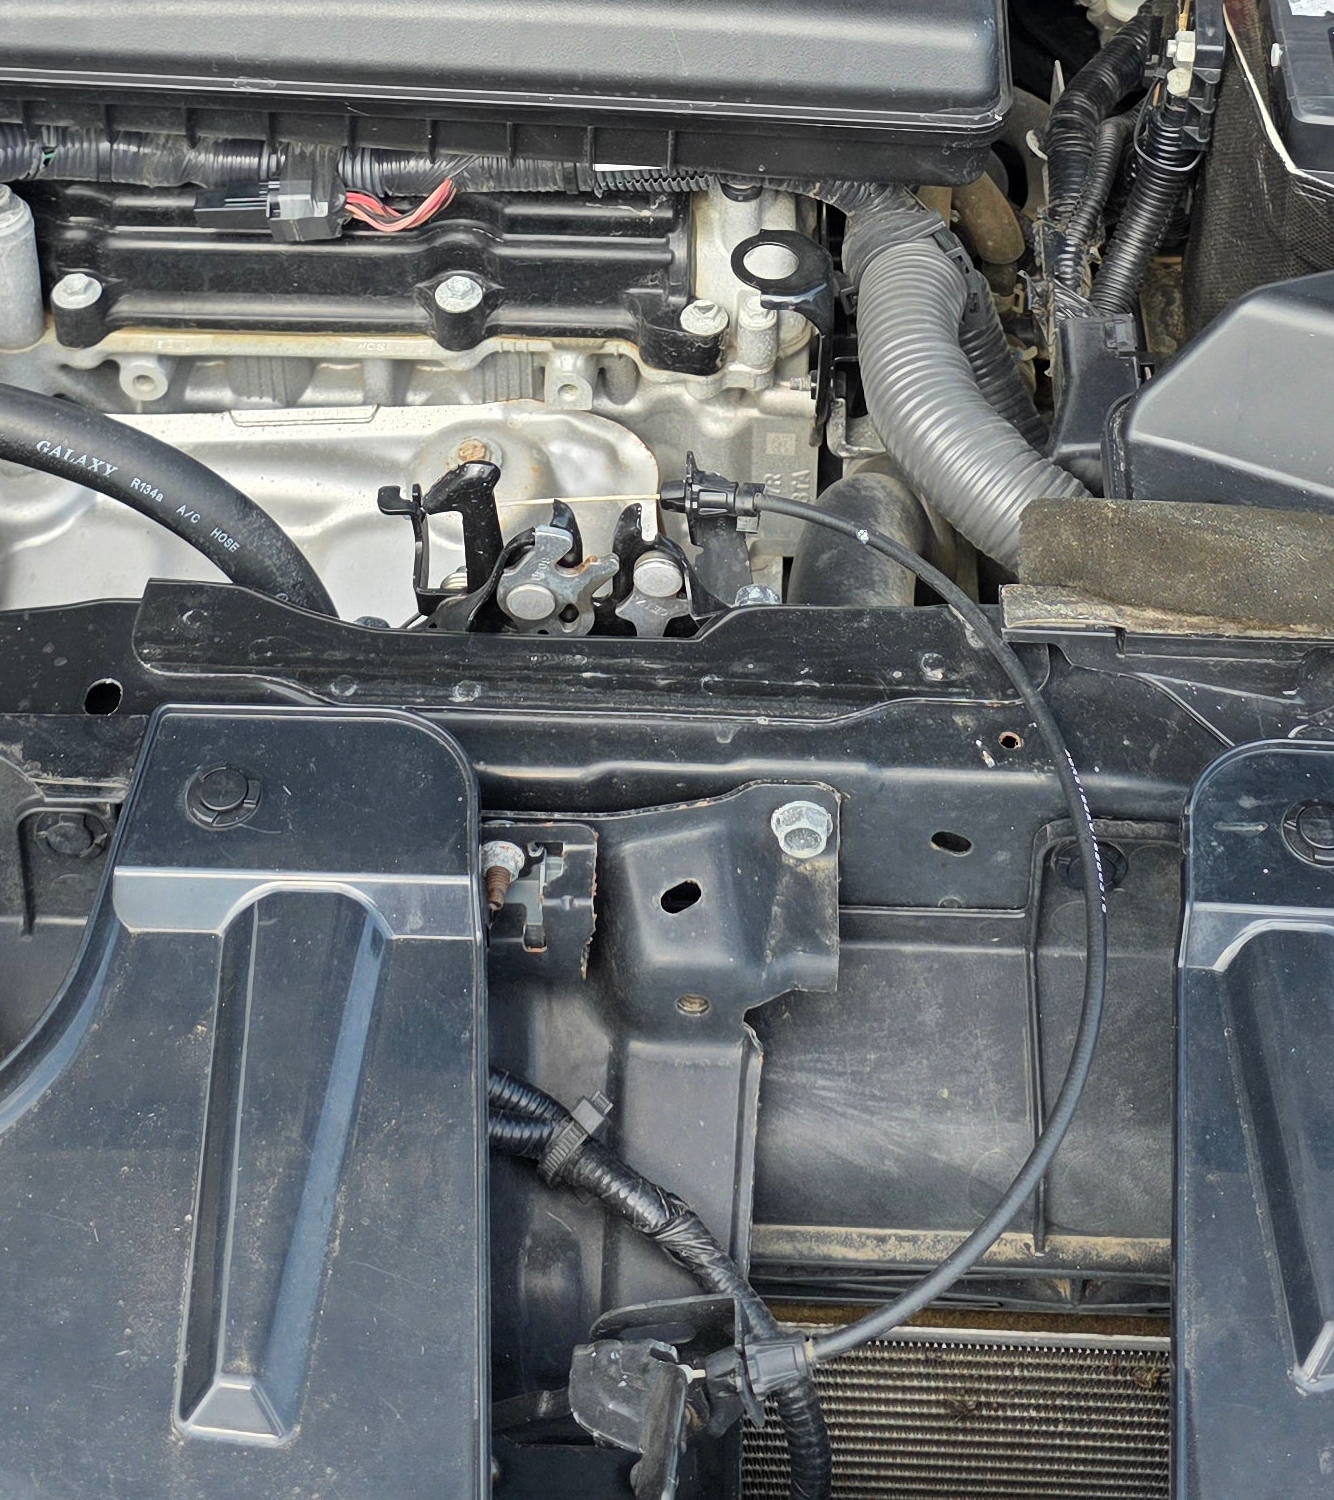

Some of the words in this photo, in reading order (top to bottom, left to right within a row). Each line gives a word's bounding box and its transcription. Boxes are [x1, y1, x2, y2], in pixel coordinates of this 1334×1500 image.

[36, 440, 118, 478] GALAXY
[130, 477, 165, 503] R134a
[176, 504, 202, 524] A/C
[210, 527, 241, 553] HOSE
